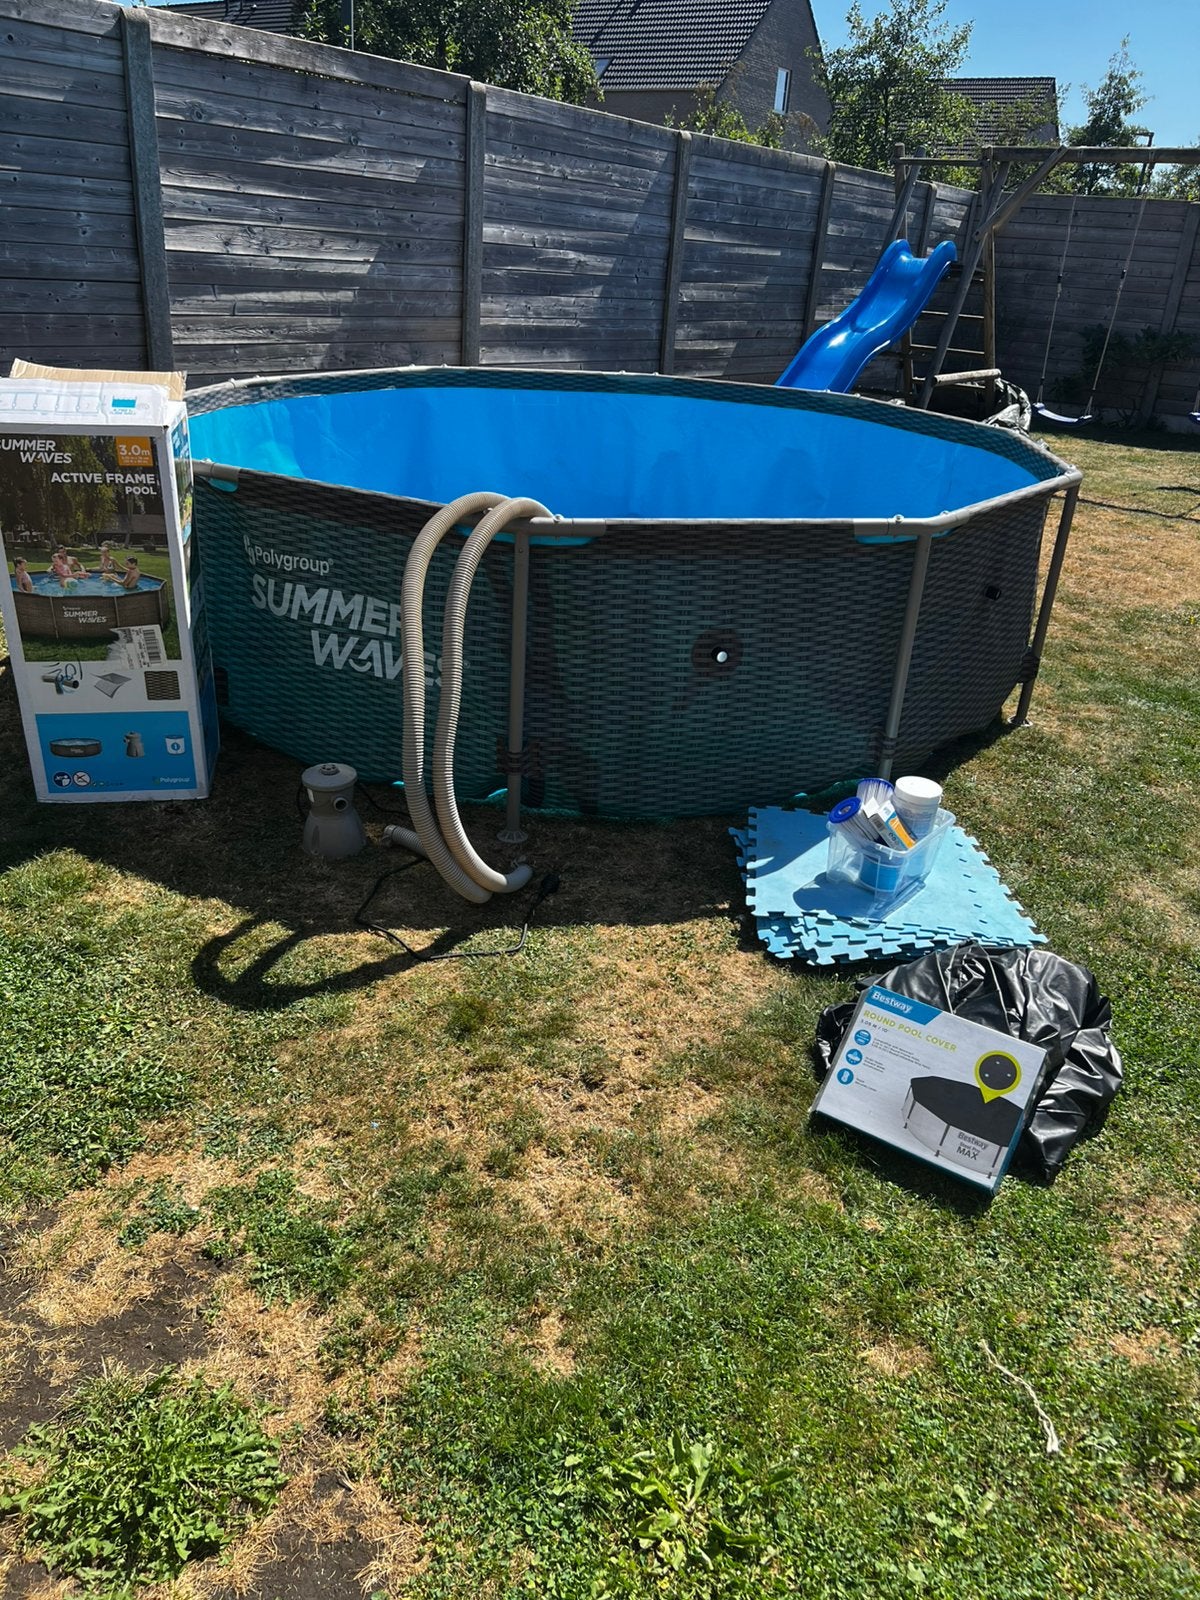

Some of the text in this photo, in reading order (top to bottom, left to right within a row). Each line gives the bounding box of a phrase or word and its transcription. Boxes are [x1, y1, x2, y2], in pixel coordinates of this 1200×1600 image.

[0, 439, 56, 451] UMMER
[118, 445, 150, 456] 3.0m
[20, 452, 72, 464] WAVES
[51, 472, 155, 484] ACTIVE FRAME
[125, 486, 157, 495] POOL
[63, 610, 98, 618] SUMMER
[872, 991, 913, 1014] Bestway
[863, 1010, 896, 1027] ROUND
[897, 1023, 922, 1039] POOL
[926, 1034, 957, 1052] COVER
[958, 1131, 989, 1150] Bestway
[956, 1146, 979, 1160] MAX
